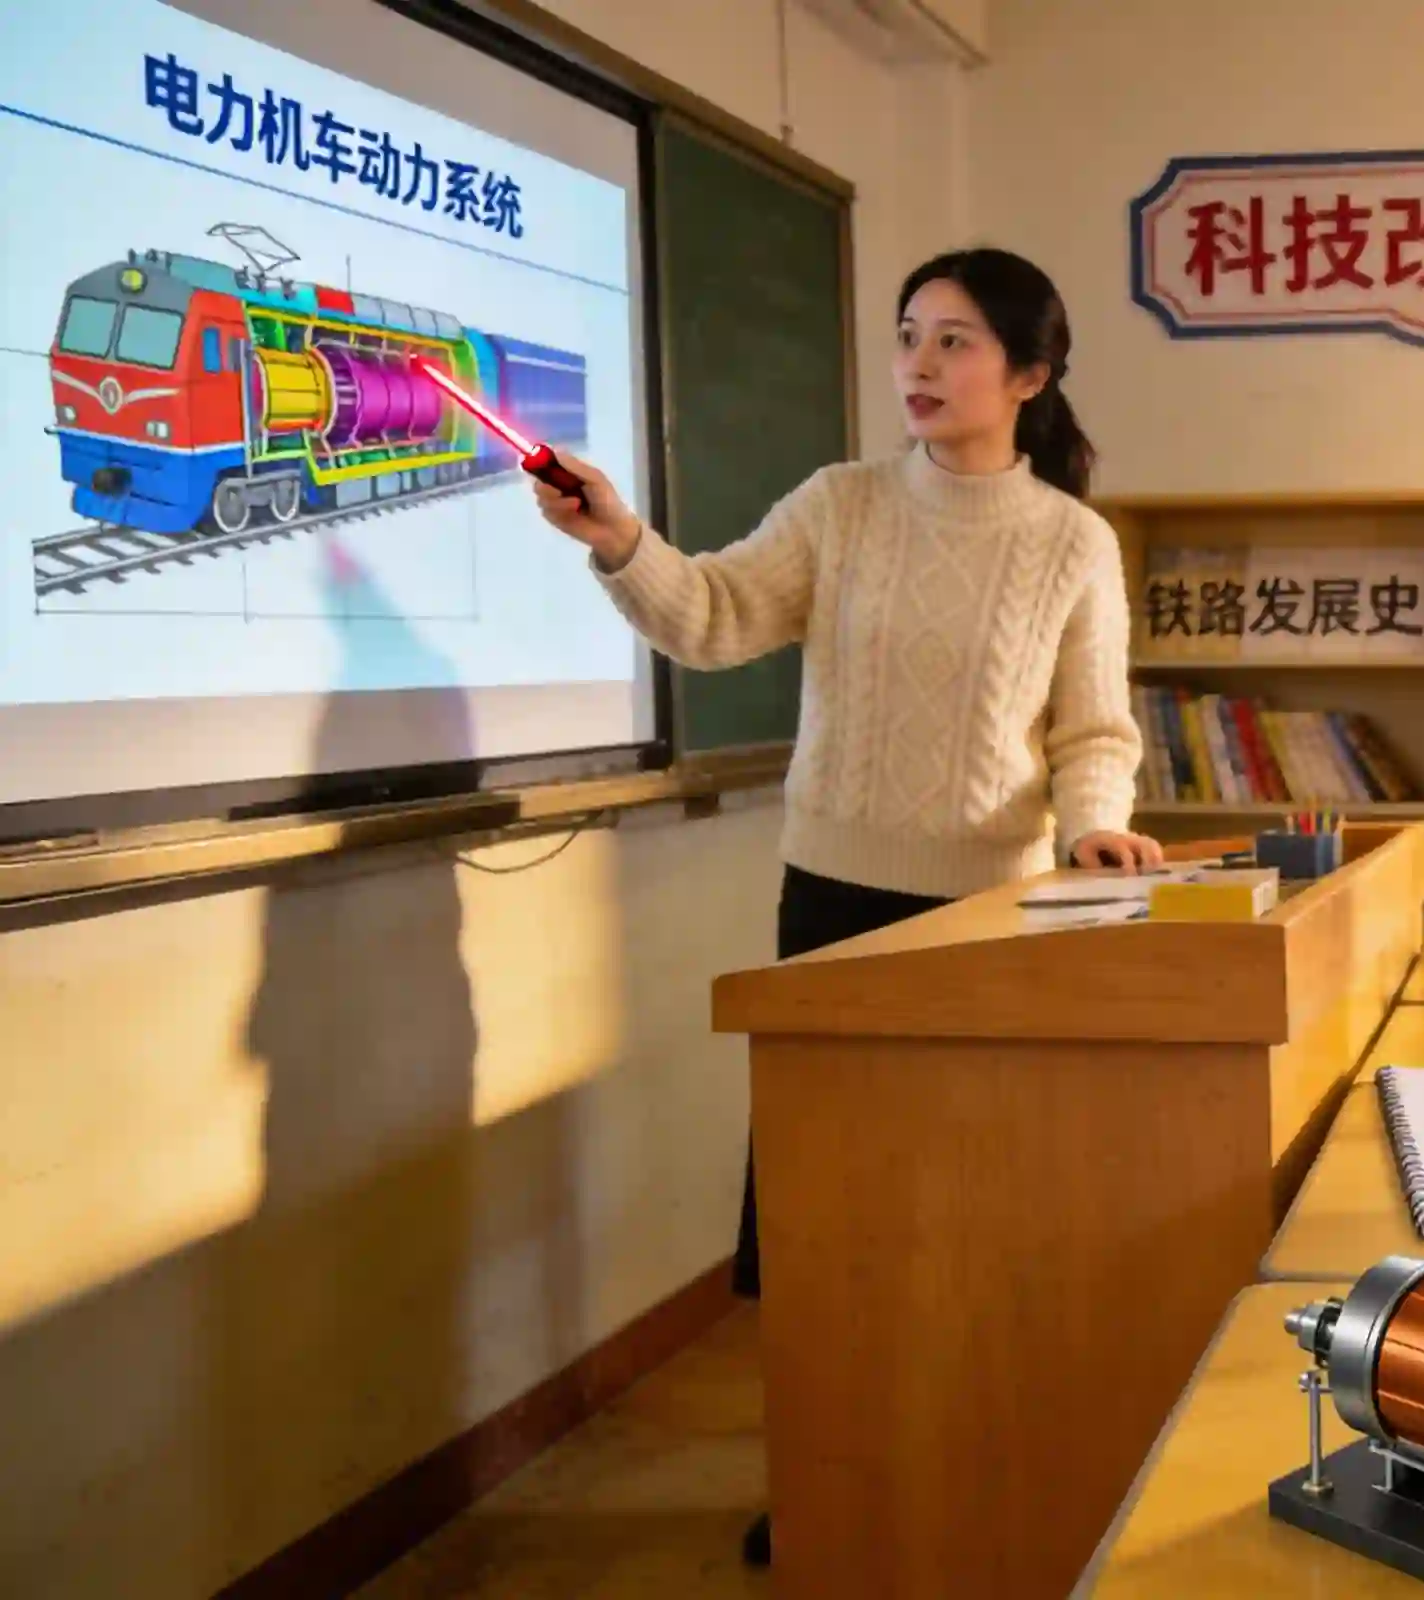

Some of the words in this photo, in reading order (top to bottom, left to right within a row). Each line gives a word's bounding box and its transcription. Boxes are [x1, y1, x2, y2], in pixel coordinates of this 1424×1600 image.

[144, 53, 523, 238] 电力机车动力系统
[1145, 574, 1424, 637] 铁路发展史
